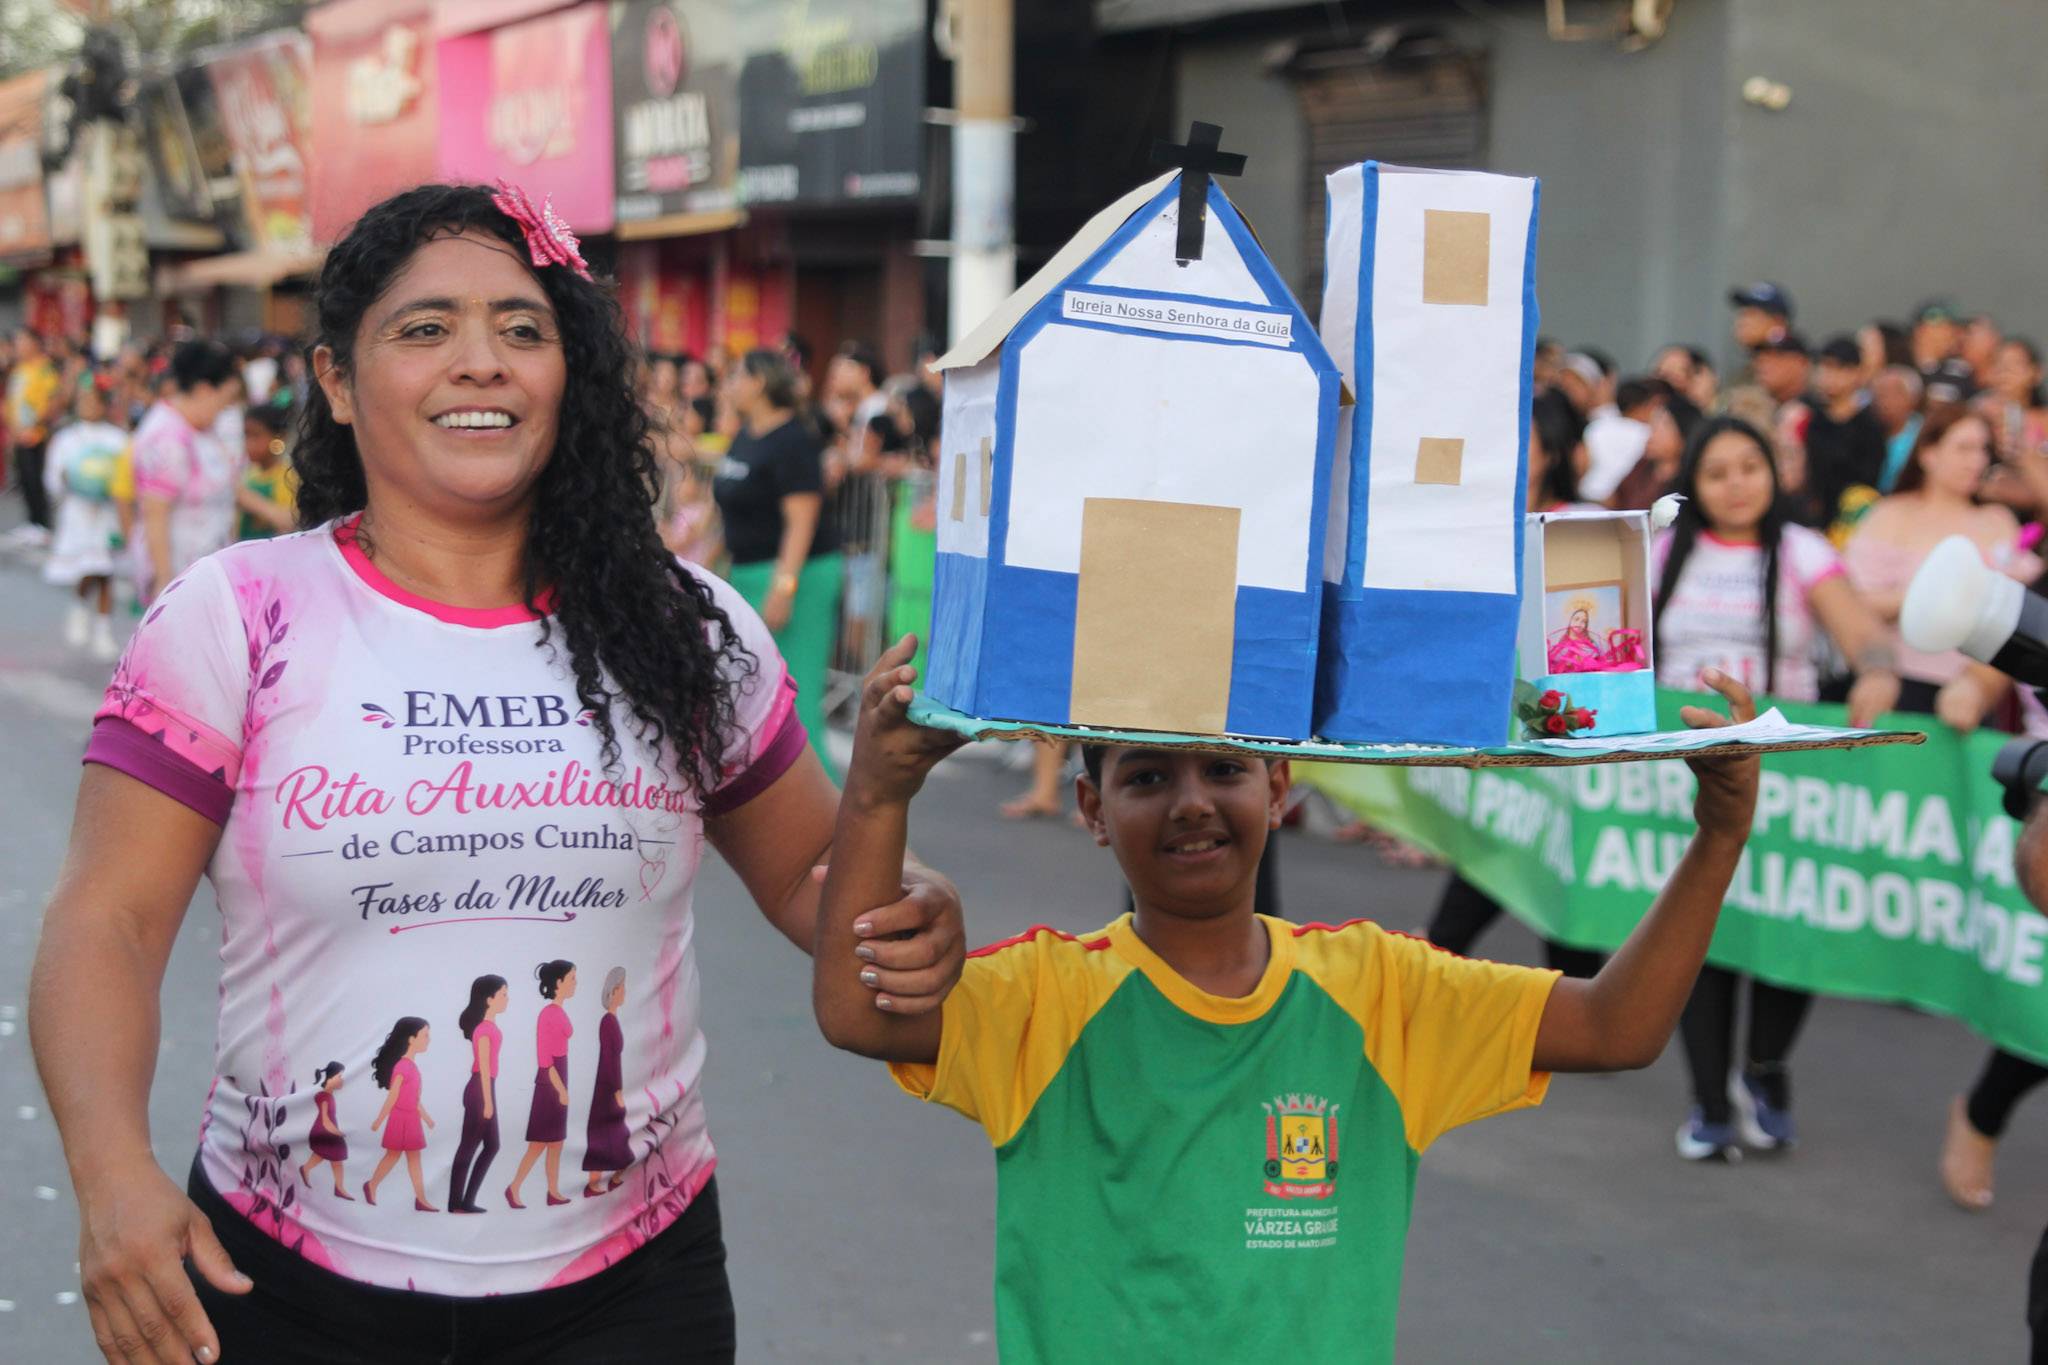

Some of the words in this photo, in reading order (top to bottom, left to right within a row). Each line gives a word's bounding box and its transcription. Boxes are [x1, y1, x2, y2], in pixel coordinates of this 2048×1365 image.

[1071, 296, 1112, 315] Igreja
[1117, 304, 1162, 320] Nossa
[1167, 309, 1229, 328] Senhora
[1233, 317, 1251, 331] da
[1255, 321, 1289, 336] Guia
[403, 690, 570, 728] EMEB
[402, 733, 564, 755] Professora
[275, 765, 395, 831] Rita
[1576, 762, 1700, 822] OBR
[1752, 768, 1963, 866] PRIMA
[342, 834, 379, 860] de
[390, 829, 524, 857] Campos
[535, 824, 633, 851] Cunha
[351, 882, 446, 920] Fases
[455, 879, 499, 911] da
[506, 873, 628, 911] Mulher
[1585, 824, 1982, 952] AULIADOR
[1245, 1217, 1302, 1235] VÁRZEA
[1304, 1218, 1338, 1235] GRE
[1246, 1208, 1300, 1217] PREFEITURA
[1301, 1206, 1338, 1217] MUNIC
[1246, 1240, 1282, 1249] ESTADO
[1284, 1240, 1296, 1249] DE
